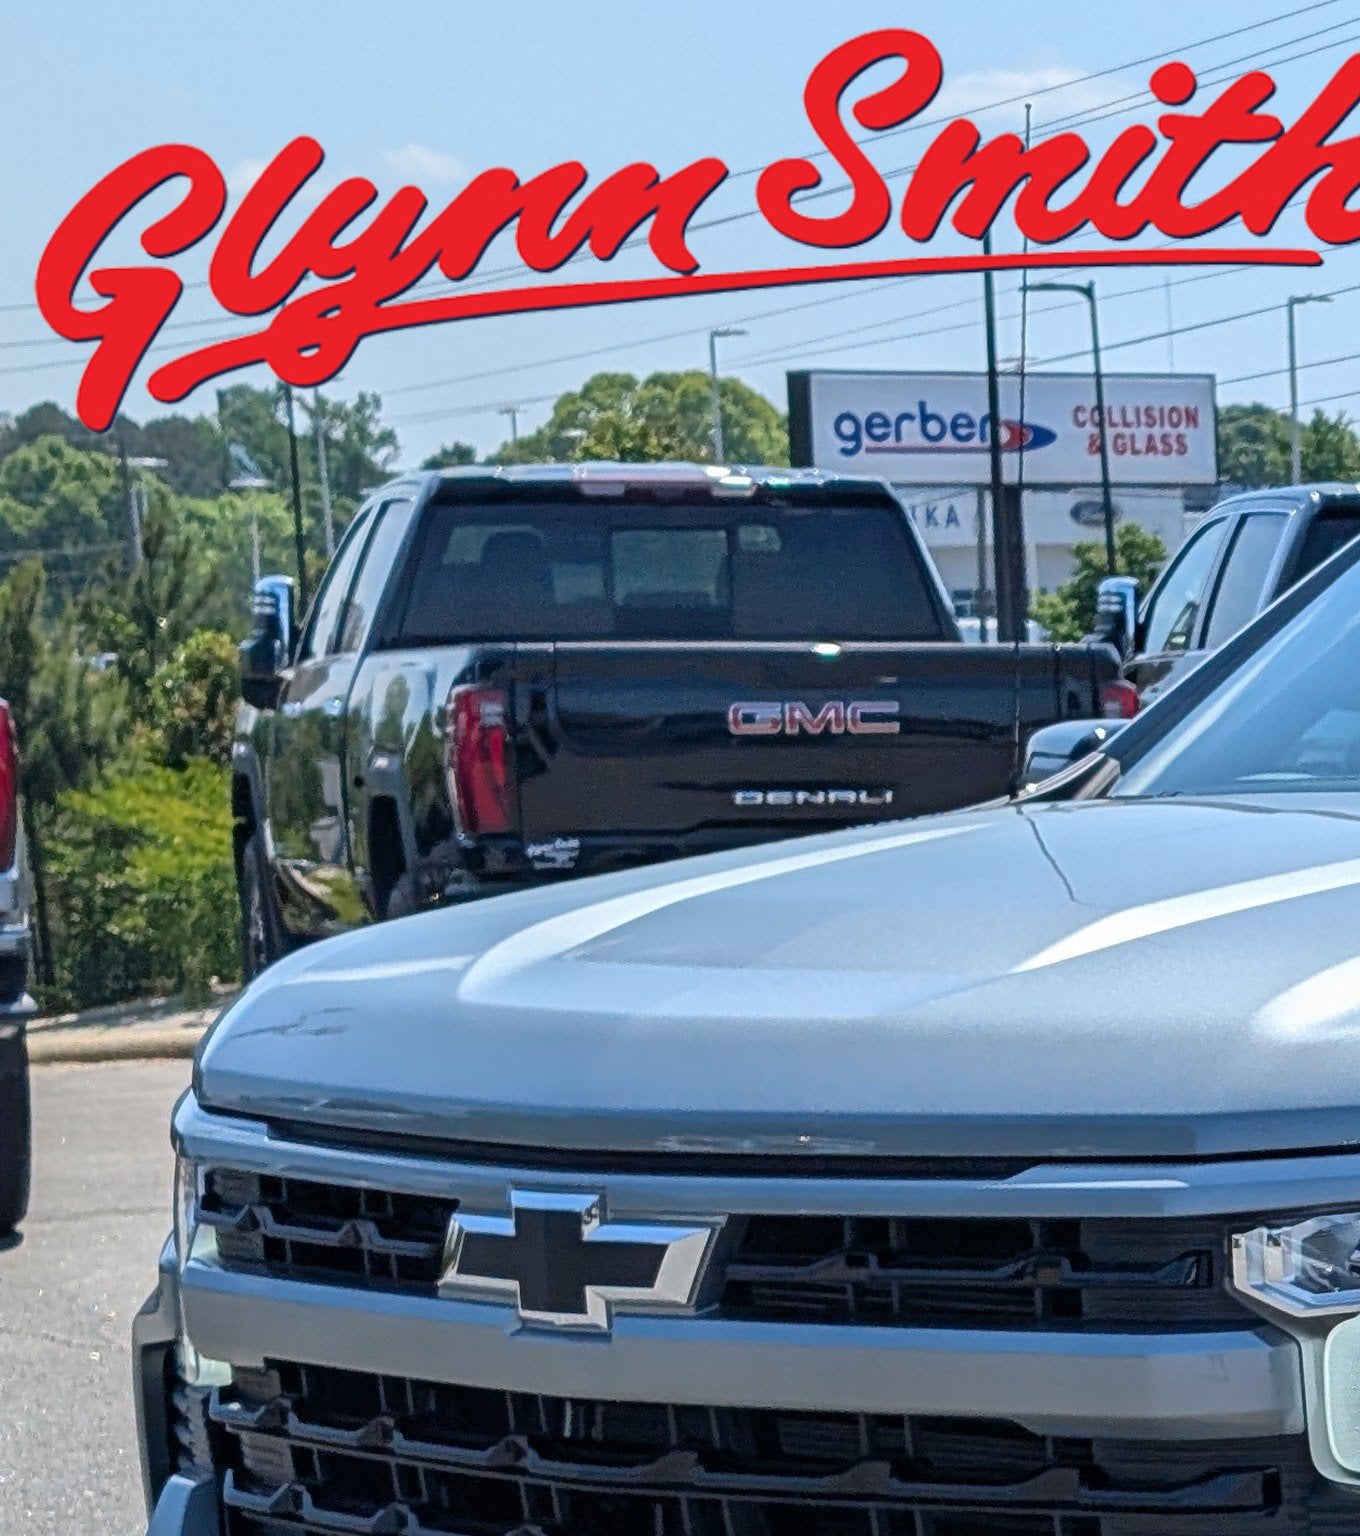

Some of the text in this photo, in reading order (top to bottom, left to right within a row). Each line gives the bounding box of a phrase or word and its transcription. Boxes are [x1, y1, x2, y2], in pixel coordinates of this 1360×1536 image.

[834, 400, 993, 456] gerber
[1072, 405, 1199, 428] COLLISION
[1112, 434, 1189, 456] GLASS
[728, 701, 900, 735] GMC
[733, 788, 893, 805] DENALI
